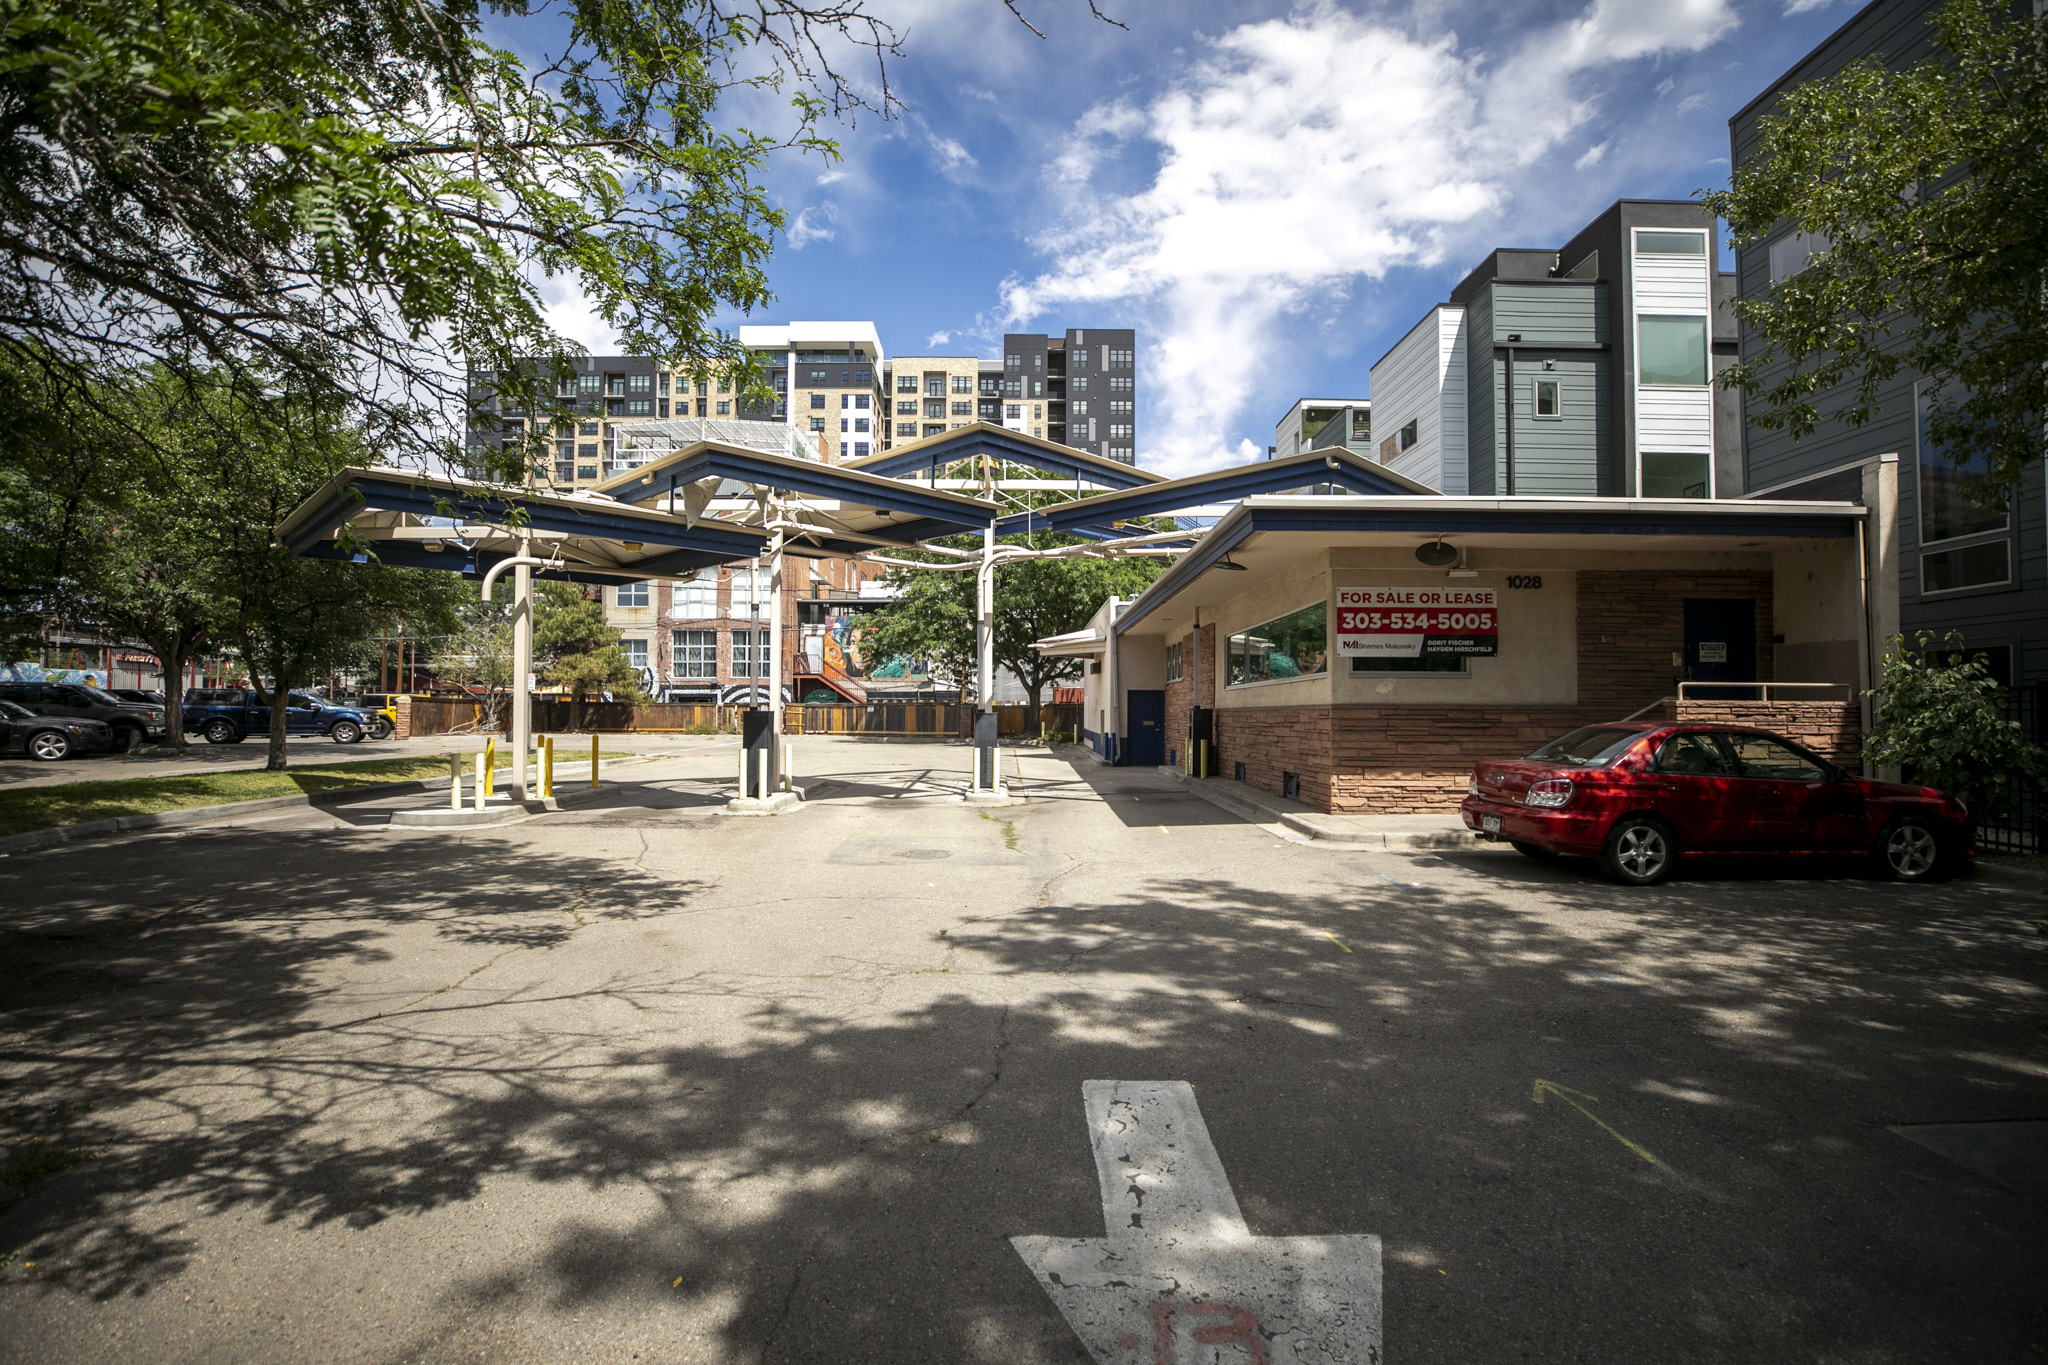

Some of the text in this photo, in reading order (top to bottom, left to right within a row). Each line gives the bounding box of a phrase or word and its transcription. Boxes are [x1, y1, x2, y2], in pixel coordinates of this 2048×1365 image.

[1505, 575, 1542, 589] 1028
[1341, 592, 1493, 604] FOR SALE OR LEASE
[1342, 612, 1492, 630] 303-534-5005
[1385, 643, 1416, 651] Makovsky
